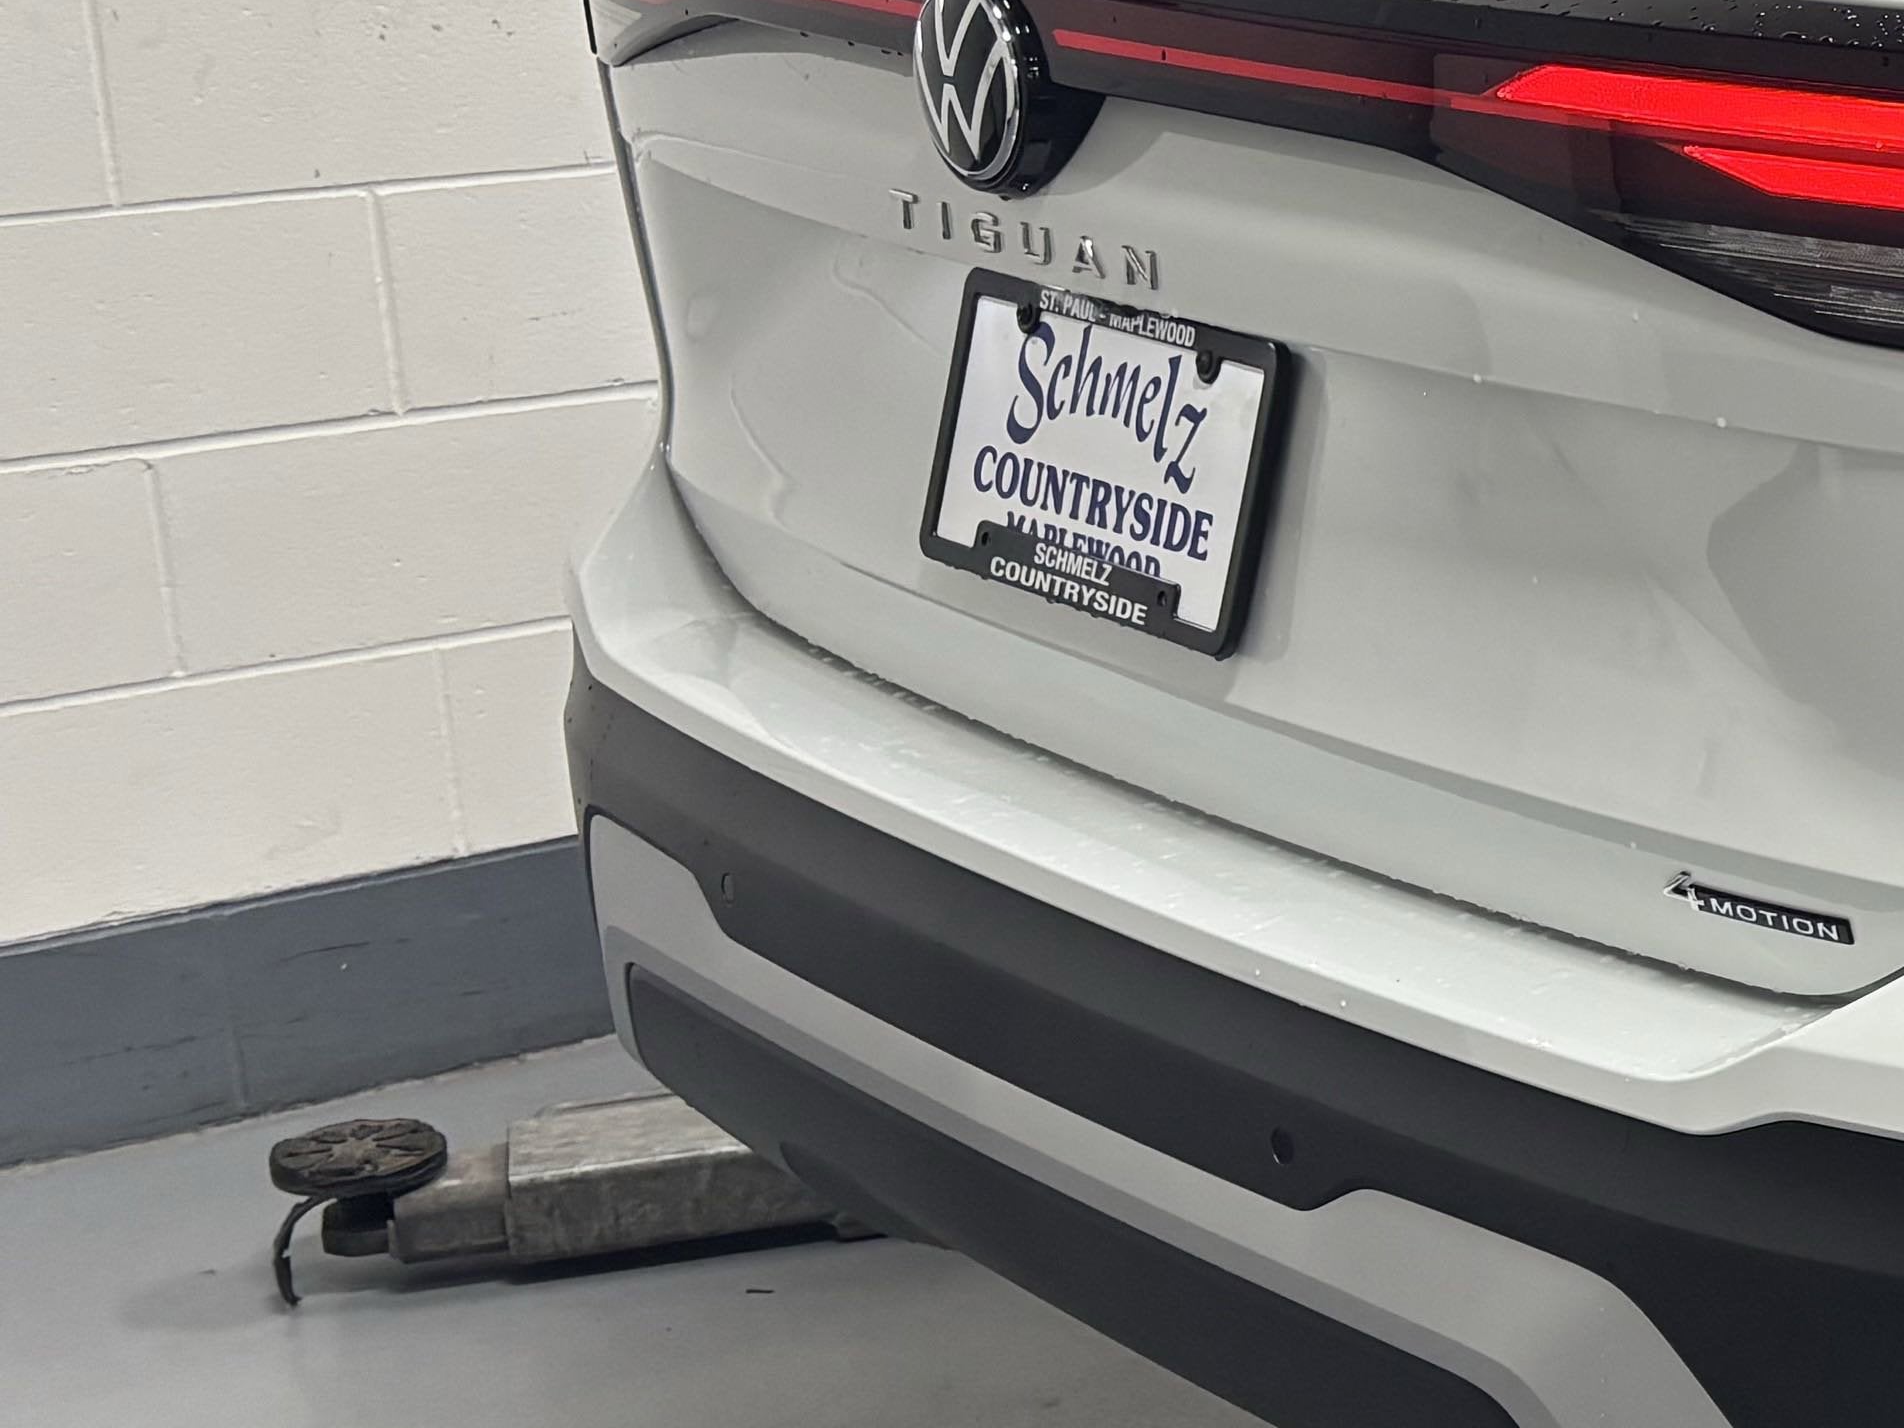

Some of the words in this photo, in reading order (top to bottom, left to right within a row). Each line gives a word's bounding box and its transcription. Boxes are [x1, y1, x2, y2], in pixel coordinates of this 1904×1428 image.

[889, 188, 1159, 290] TIGUAN
[1040, 289, 1059, 312] ST.
[1062, 294, 1096, 321] PAUL
[1109, 313, 1196, 347] MAPLEWOOD
[1006, 321, 1208, 494] Schmelz
[973, 445, 1214, 561] COUNTRYSIDE
[990, 556, 1148, 625] COUNTRYSIDE
[1033, 542, 1112, 586] SCHMELZ
